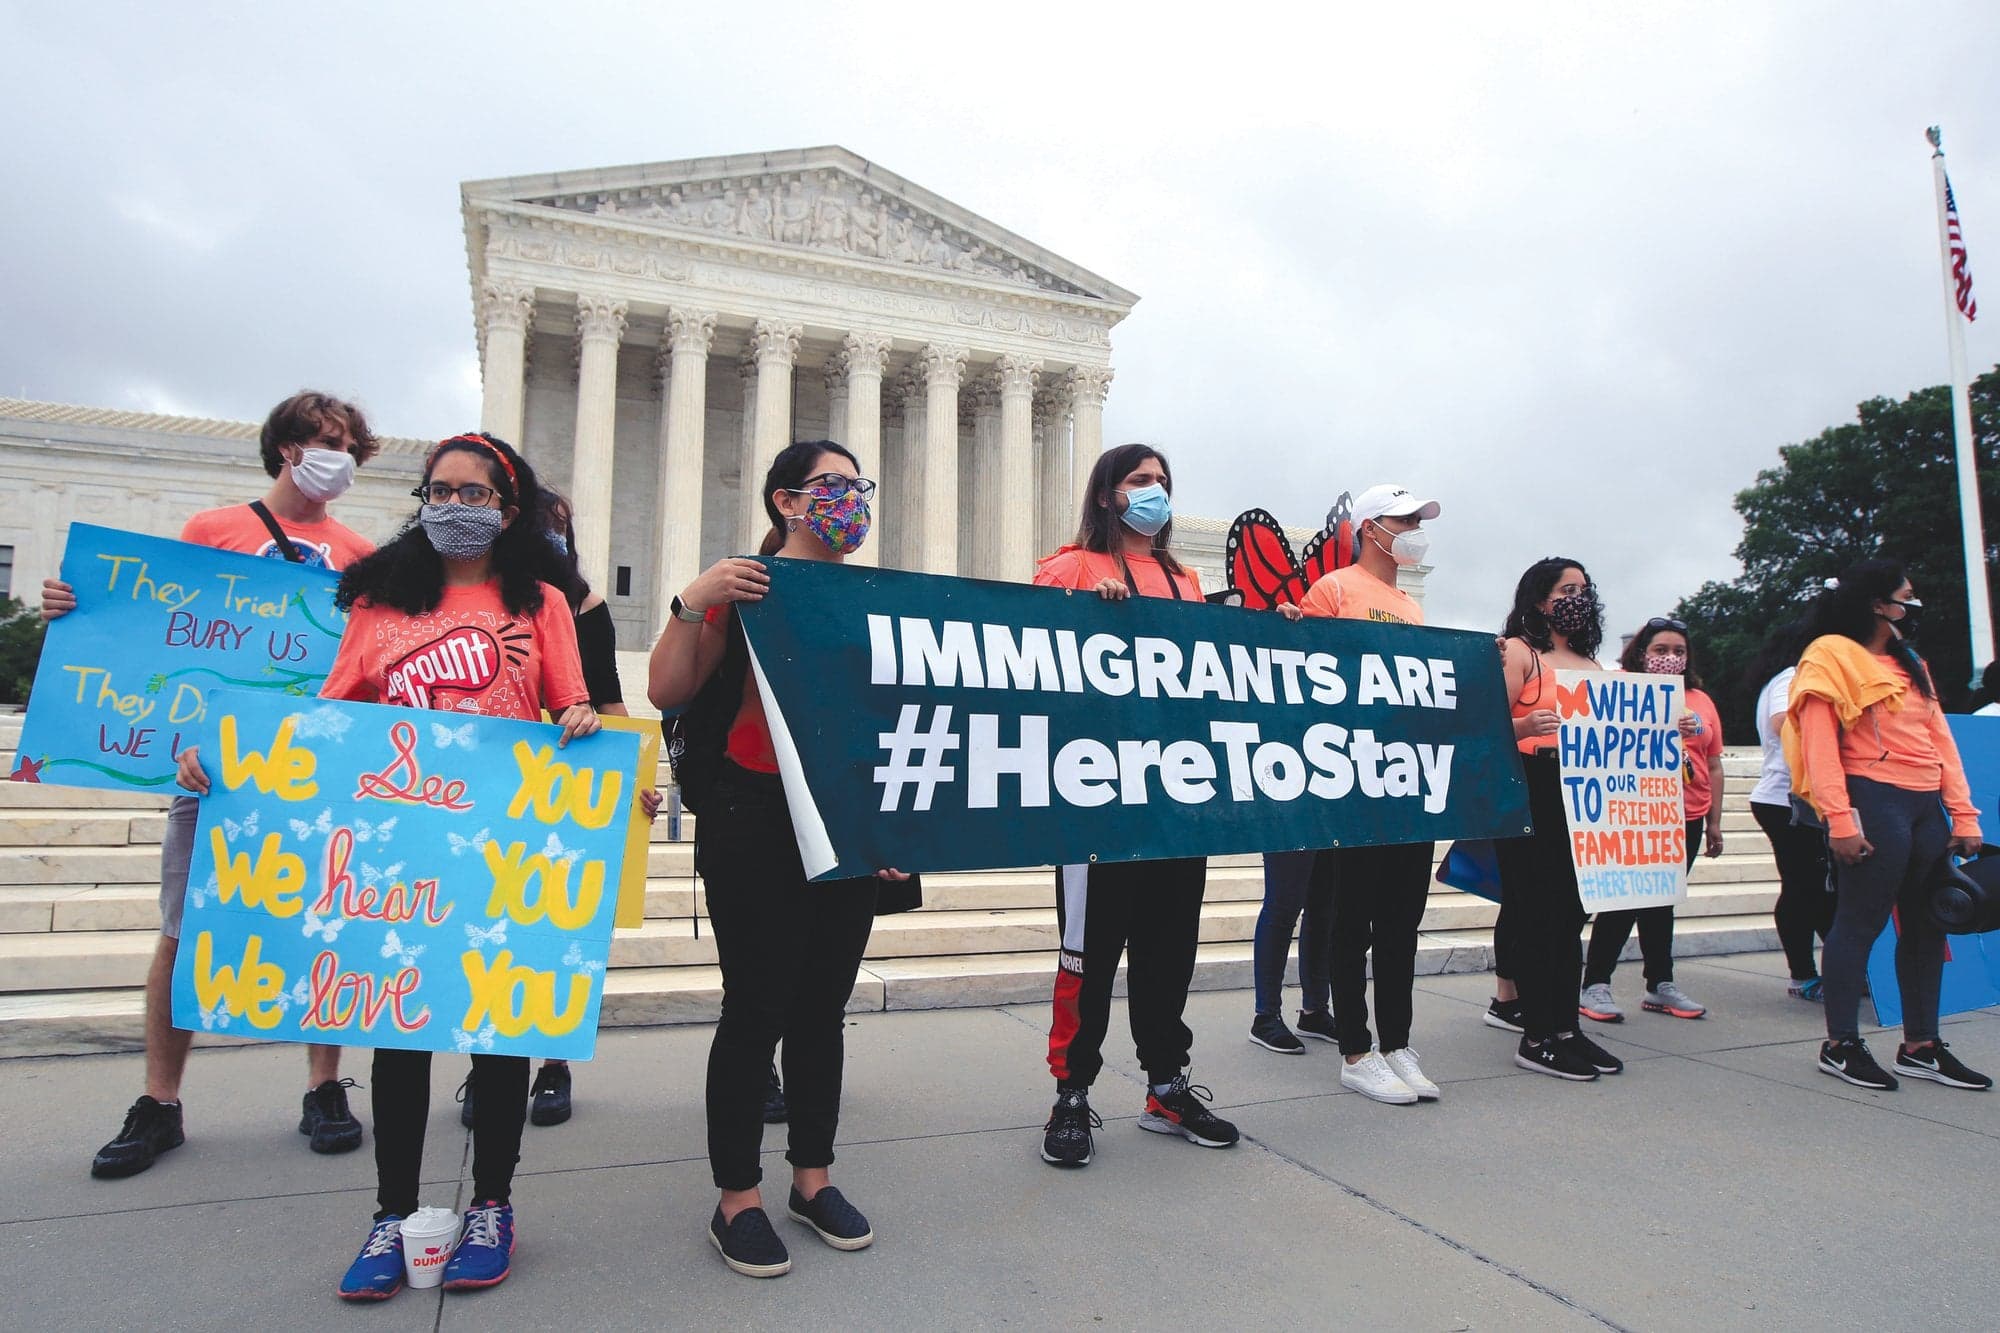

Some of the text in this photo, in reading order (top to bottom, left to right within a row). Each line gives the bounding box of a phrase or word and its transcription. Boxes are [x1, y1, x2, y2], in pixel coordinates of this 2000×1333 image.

[97, 554, 200, 612] They
[216, 574, 288, 618] Tried
[165, 611, 308, 662] BURY US
[866, 613, 1457, 710] IMMIGRANTS ARE
[63, 665, 207, 725] They Di
[1586, 679, 1675, 725] WHAT
[99, 724, 156, 758] WE
[220, 715, 319, 801] We
[353, 721, 475, 811] See
[873, 703, 1454, 815] #HereToStay
[1560, 724, 1680, 771] HAPPENS
[1563, 776, 1602, 823] TO
[1606, 774, 1637, 793] OUR
[1573, 828, 1686, 867] FAMILIES
[209, 827, 307, 918] We
[314, 828, 453, 926] hear
[1581, 869, 1677, 899] #HERETOSTAY
[193, 931, 285, 1030] We
[300, 950, 430, 1032] love
